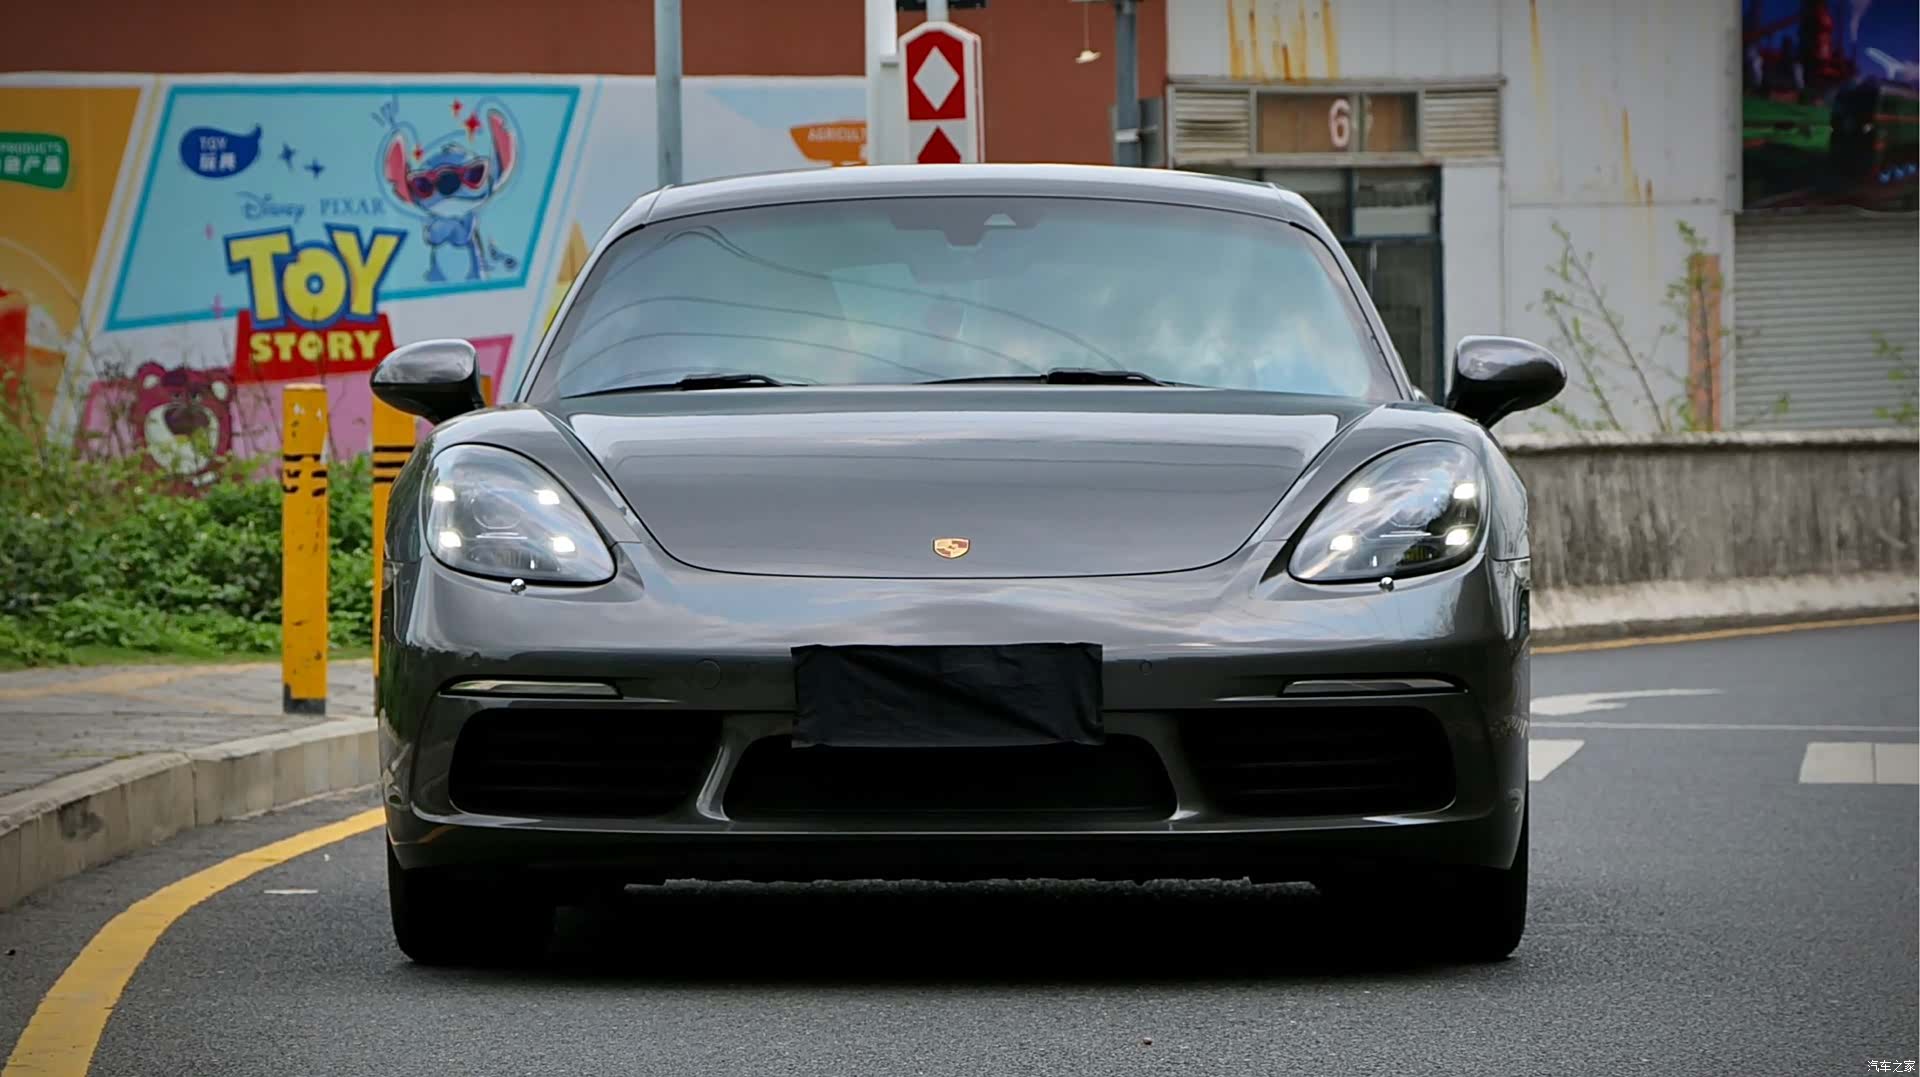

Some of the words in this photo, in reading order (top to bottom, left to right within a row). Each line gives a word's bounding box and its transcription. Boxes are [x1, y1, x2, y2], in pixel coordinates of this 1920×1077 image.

[1328, 98, 1351, 148] 6
[236, 191, 304, 223] Disney
[319, 198, 385, 216] PIXAR
[224, 223, 409, 329] TOY
[250, 331, 382, 362] STORY
